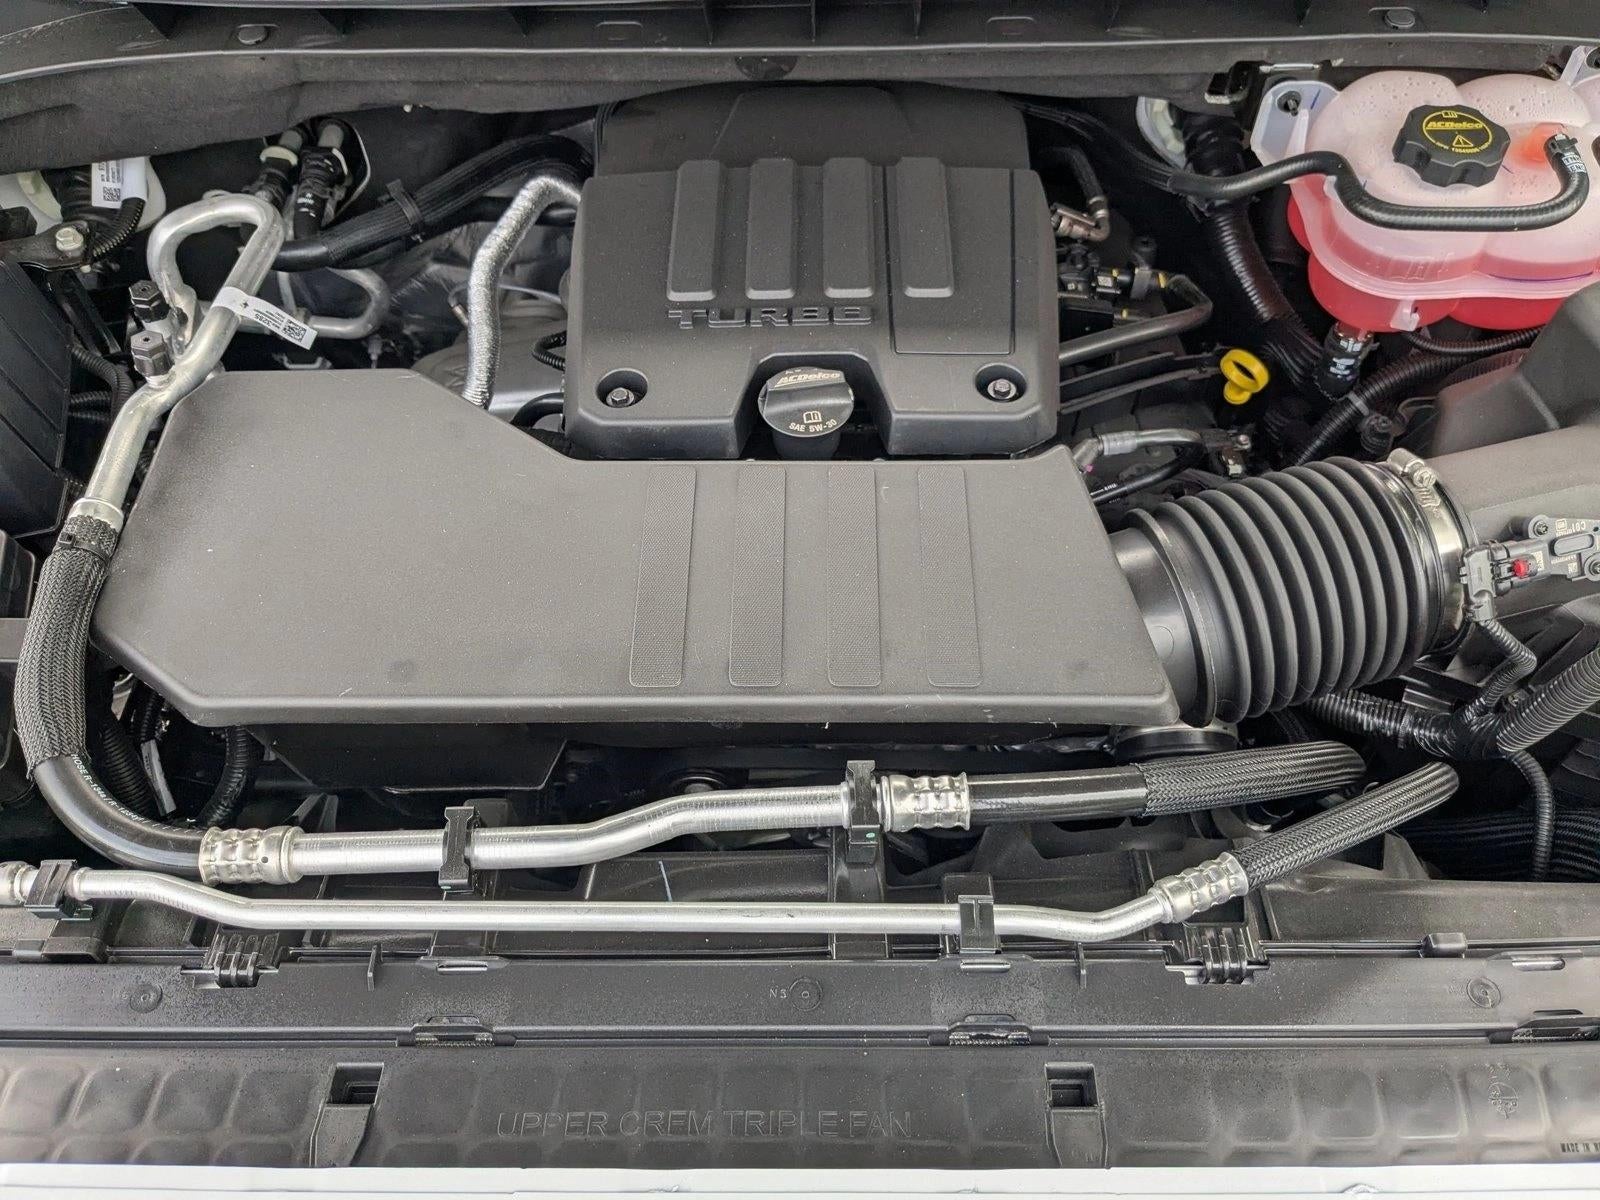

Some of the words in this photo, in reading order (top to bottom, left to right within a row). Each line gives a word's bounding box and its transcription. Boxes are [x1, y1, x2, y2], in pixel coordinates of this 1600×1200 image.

[1426, 121, 1483, 129] ACDelco
[668, 305, 872, 330] TURBO
[775, 372, 841, 386] ACDelco
[789, 422, 805, 432] SAE
[809, 419, 837, 433] 5W-30
[71, 753, 88, 774] HOSE
[497, 1112, 609, 1137] UPPER
[723, 1110, 838, 1137] TRIPLE
[850, 1110, 912, 1137] FAN
